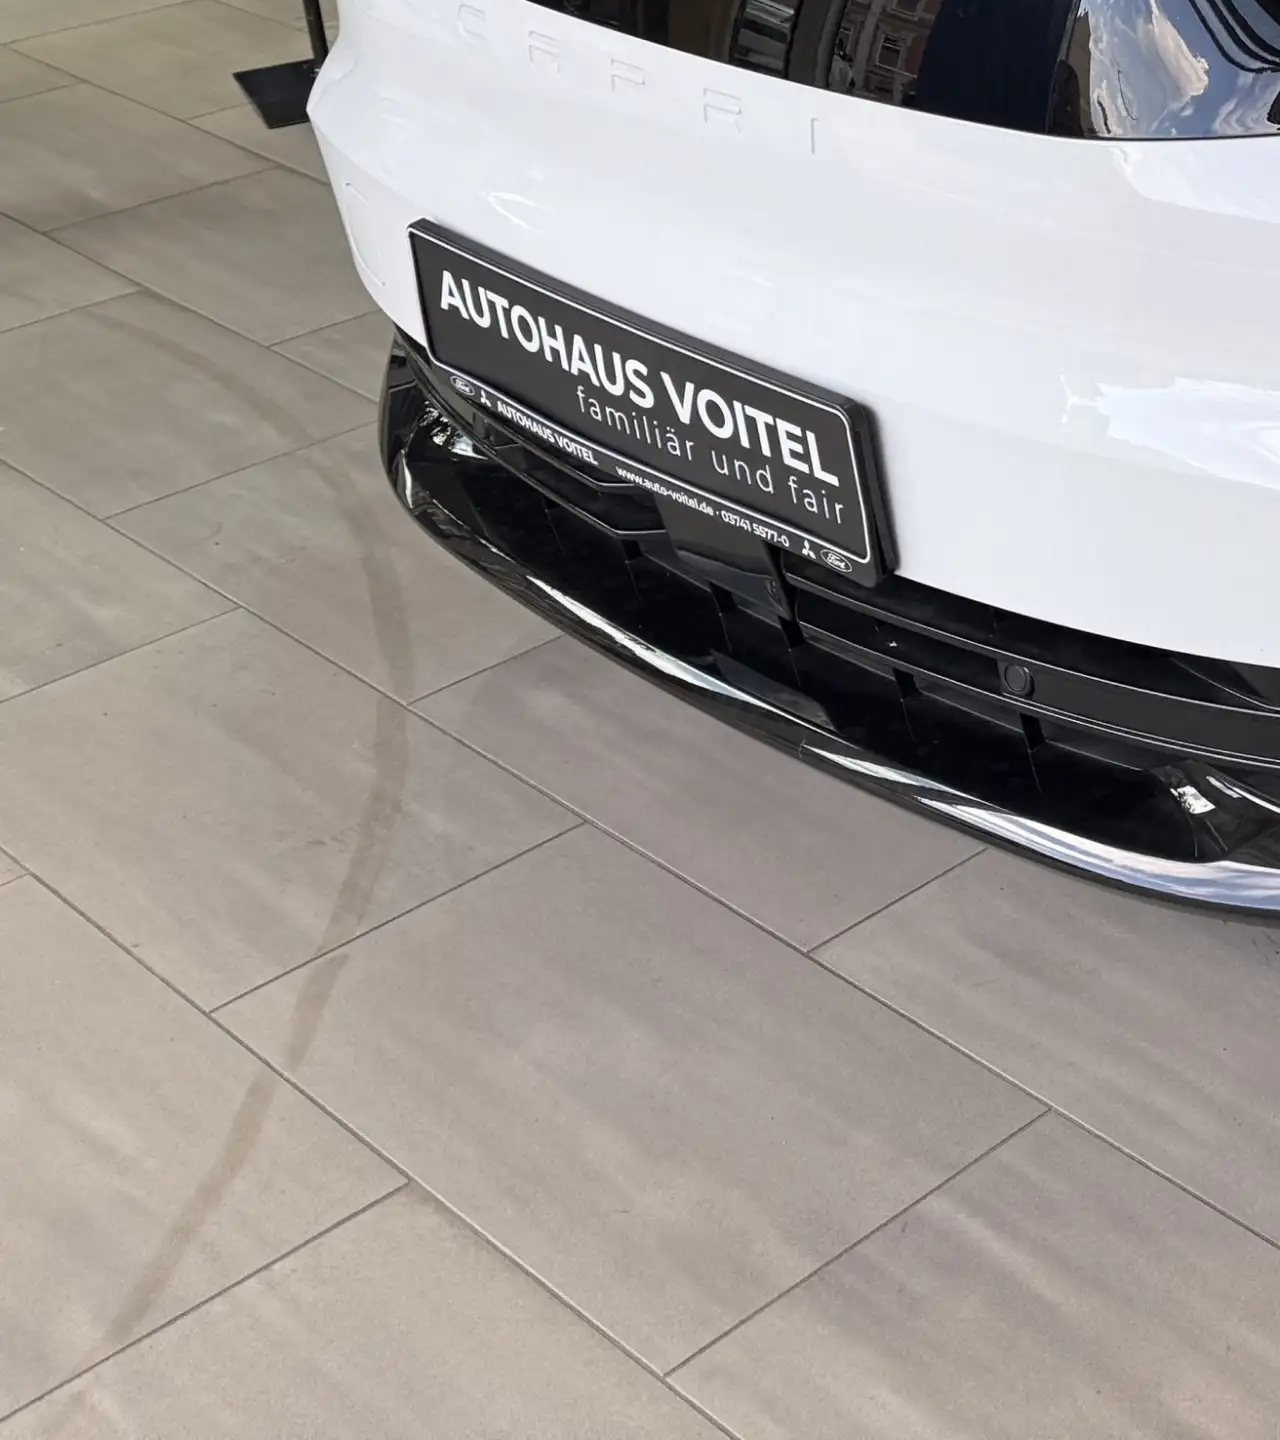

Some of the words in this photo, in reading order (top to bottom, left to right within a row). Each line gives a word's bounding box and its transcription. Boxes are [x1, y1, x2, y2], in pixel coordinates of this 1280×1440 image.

[457, 3, 820, 155] CAPRI
[440, 270, 654, 409] AUTOHAUS
[659, 371, 840, 487] VOITEL
[497, 401, 555, 443] AUTOHAUS
[554, 433, 599, 466] VOITEL
[576, 385, 695, 461] familiär
[712, 450, 774, 494] und
[788, 475, 844, 525] fair
[616, 466, 714, 517] www.auto-voitel.de
[721, 511, 752, 532] 03741
[752, 523, 789, 548] 5577-0
